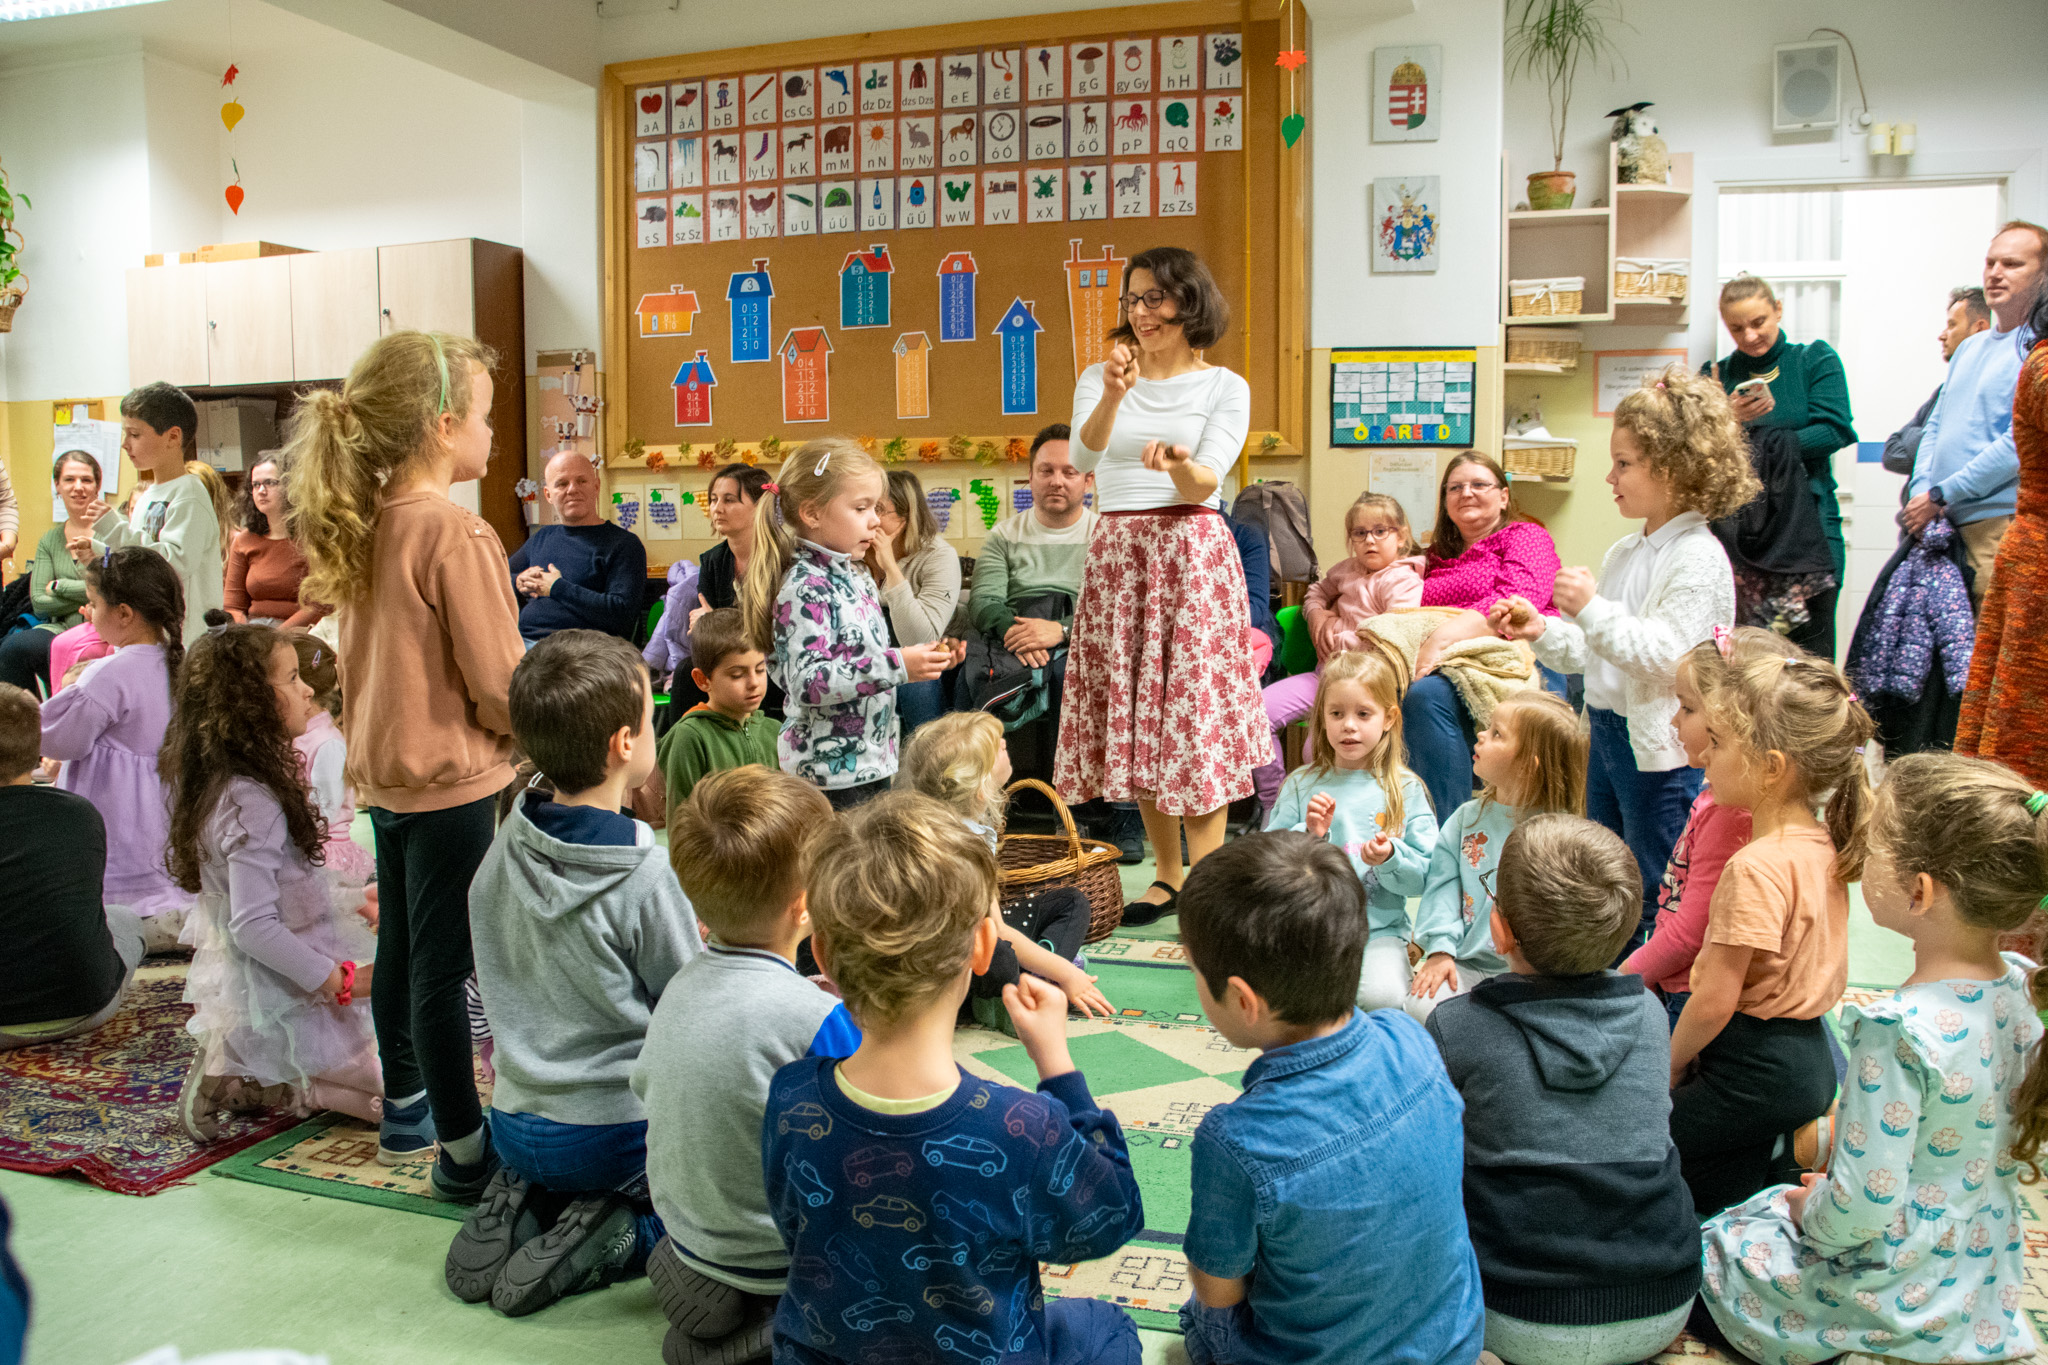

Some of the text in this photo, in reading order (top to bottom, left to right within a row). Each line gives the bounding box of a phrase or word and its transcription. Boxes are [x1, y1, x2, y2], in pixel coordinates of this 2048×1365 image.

[1079, 77, 1099, 94] g G
[1117, 78, 1149, 93] gy Gy
[1167, 74, 1190, 88] h H
[993, 85, 1011, 100] é É
[1038, 83, 1054, 97] f F
[951, 91, 968, 104] e E
[827, 101, 847, 115] d D
[862, 98, 891, 111] dz Dz
[752, 108, 768, 121] c C
[784, 105, 812, 118] cs Cs
[679, 115, 695, 130] á Á
[714, 113, 732, 126] b B
[644, 121, 659, 133] a A
[1122, 139, 1142, 154] p P
[1167, 137, 1189, 151] q Q
[1215, 135, 1232, 147] r R
[992, 145, 1012, 160] ó Ó
[1035, 141, 1056, 156] ö Ö
[868, 156, 886, 168] n N
[902, 154, 933, 168] ny Ny
[949, 150, 969, 163] o O
[790, 161, 808, 175] k K
[826, 158, 849, 171] m M
[687, 171, 694, 184] J
[724, 169, 730, 182] L
[749, 165, 774, 180] ly Ly
[1036, 206, 1053, 218] x X
[1079, 204, 1097, 219] y Y
[1123, 201, 1141, 214] z Z
[1162, 200, 1194, 213] zs Zs
[868, 216, 874, 227] ü
[945, 210, 970, 223] w W
[992, 209, 1010, 221] v V
[791, 220, 809, 232] u U
[829, 215, 848, 230] ú Ú
[675, 229, 701, 242] sz Sz
[718, 225, 732, 238] t T
[749, 223, 775, 238] ty Ty
[645, 232, 660, 244] s S
[747, 280, 753, 290] 3
[742, 303, 758, 313] 0 3
[743, 315, 758, 325] 1 2
[742, 328, 758, 337] 2 1
[742, 340, 758, 350] 3 0
[789, 349, 795, 359] 4
[798, 358, 813, 368] 0 4
[799, 370, 814, 380] 1 3
[798, 382, 815, 393] 2 2
[798, 394, 814, 404] 3 1
[798, 406, 815, 415] 4 0
